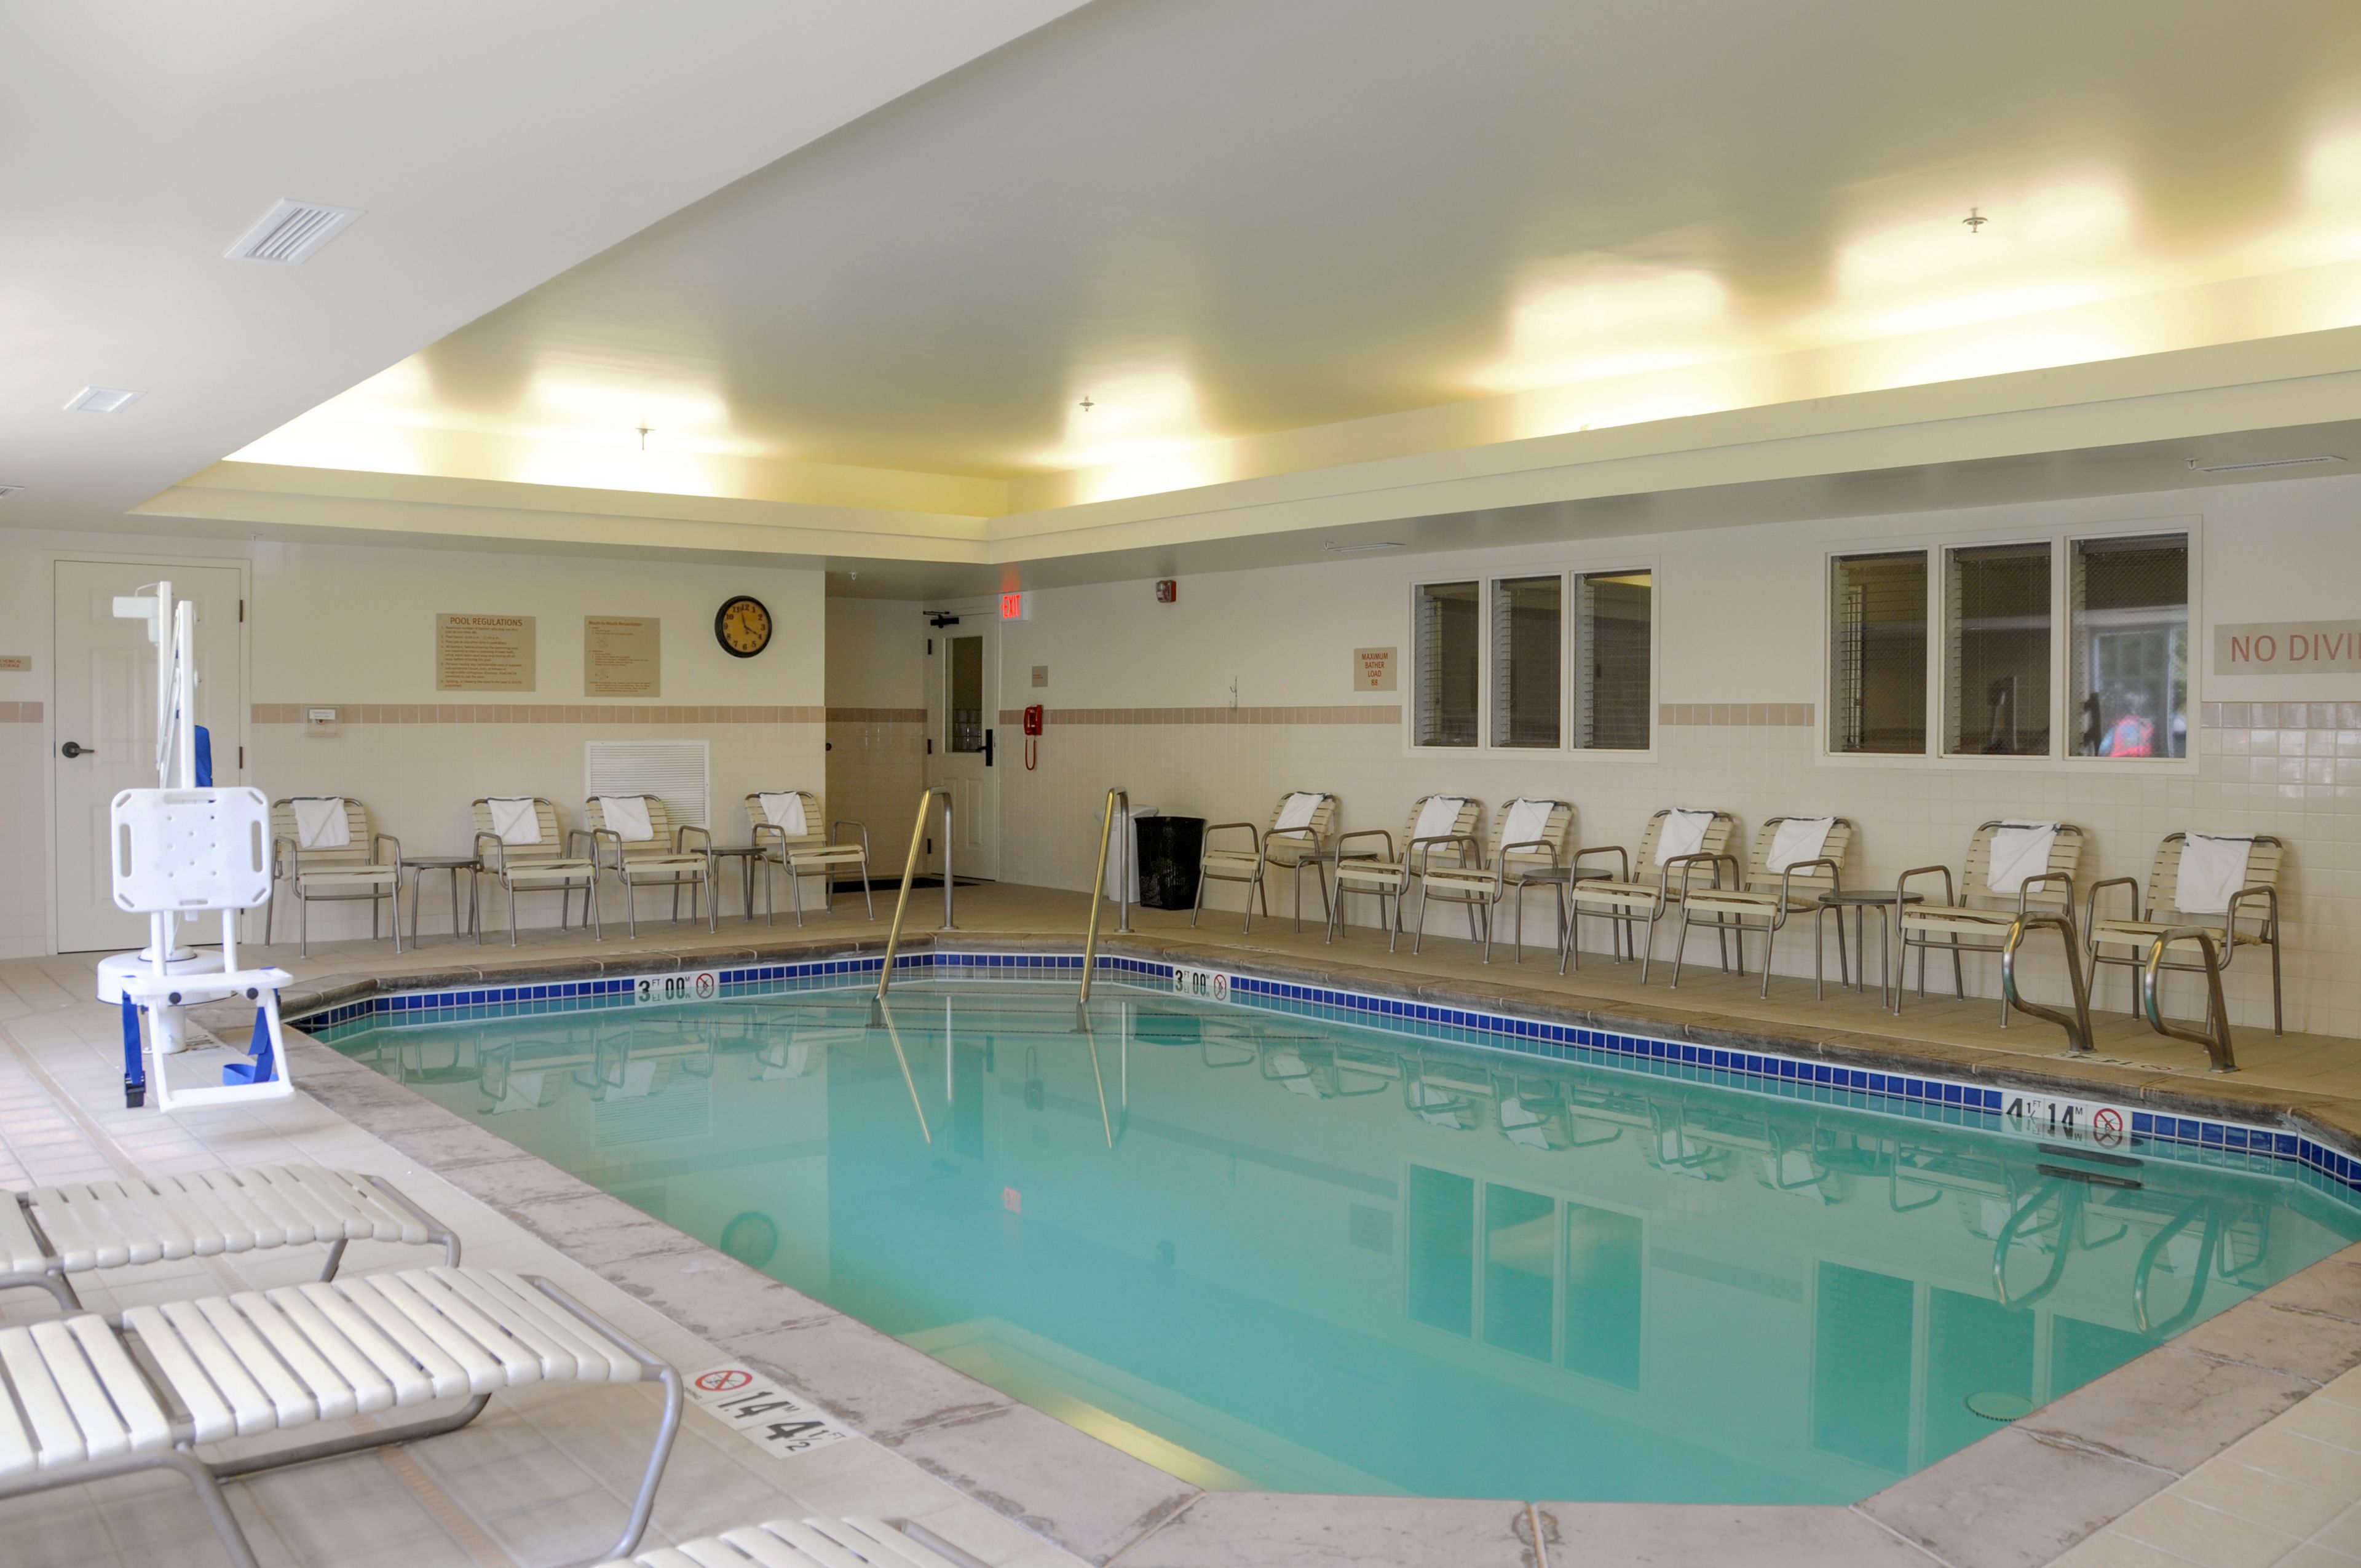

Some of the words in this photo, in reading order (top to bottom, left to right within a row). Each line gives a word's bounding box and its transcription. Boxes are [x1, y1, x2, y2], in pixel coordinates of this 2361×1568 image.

[1003, 595, 1021, 618] EXIT
[472, 617, 523, 627] REGULATIONS
[2231, 635, 2277, 662] NO
[2290, 633, 2361, 662] DIVI
[2075, 1106, 2083, 1115] M
[781, 1404, 801, 1413] M
[828, 1431, 847, 1440] FT
